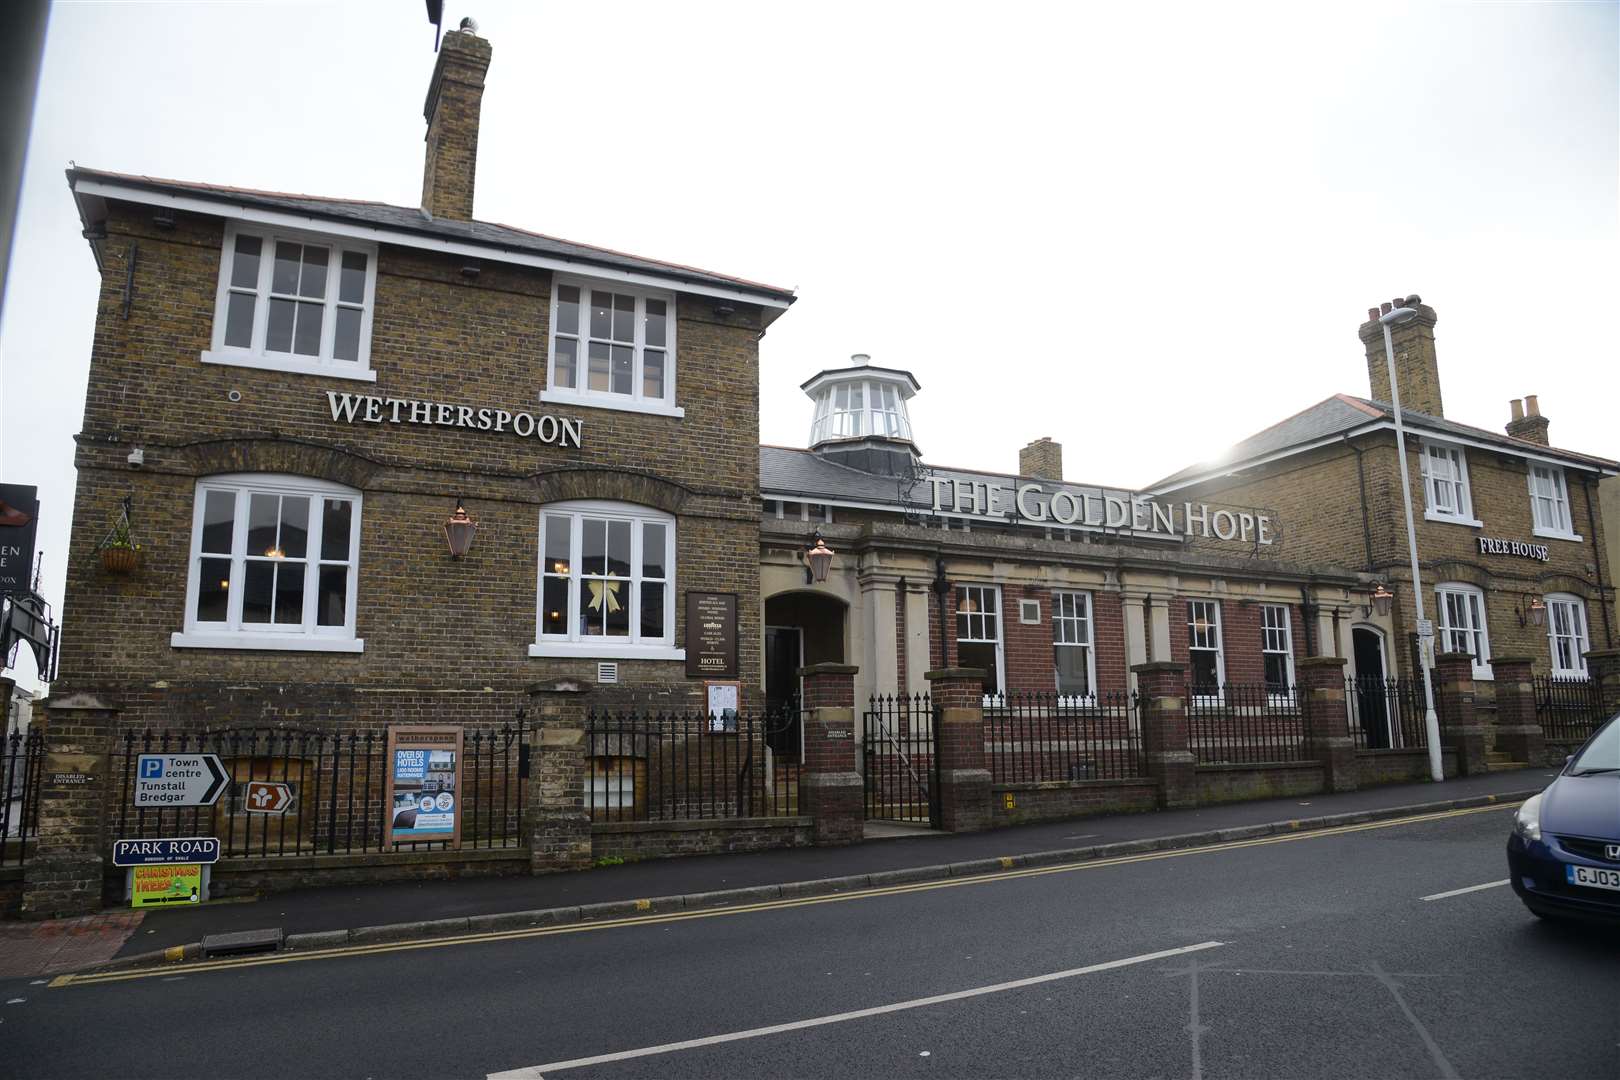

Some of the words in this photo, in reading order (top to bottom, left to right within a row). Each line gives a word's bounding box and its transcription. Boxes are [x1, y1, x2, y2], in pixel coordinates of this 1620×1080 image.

[326, 391, 584, 449] WETHERSPOON
[926, 476, 1005, 517] THE
[1016, 484, 1175, 537] GOLDEN
[1184, 502, 1274, 545] HOPE
[1480, 537, 1510, 554] FREE
[1511, 541, 1550, 561] HOUSE
[397, 750, 415, 759] OVER
[146, 760, 160, 777] P
[169, 758, 199, 767] Town
[397, 758, 424, 767] HOTELS
[165, 769, 202, 778] centre
[141, 781, 186, 791] Tunstall
[140, 793, 185, 803] Bredgar
[120, 842, 163, 855] PARK
[169, 840, 214, 854] ROAD
[136, 866, 199, 879] CHRISTMAS
[136, 880, 171, 893] TREES
